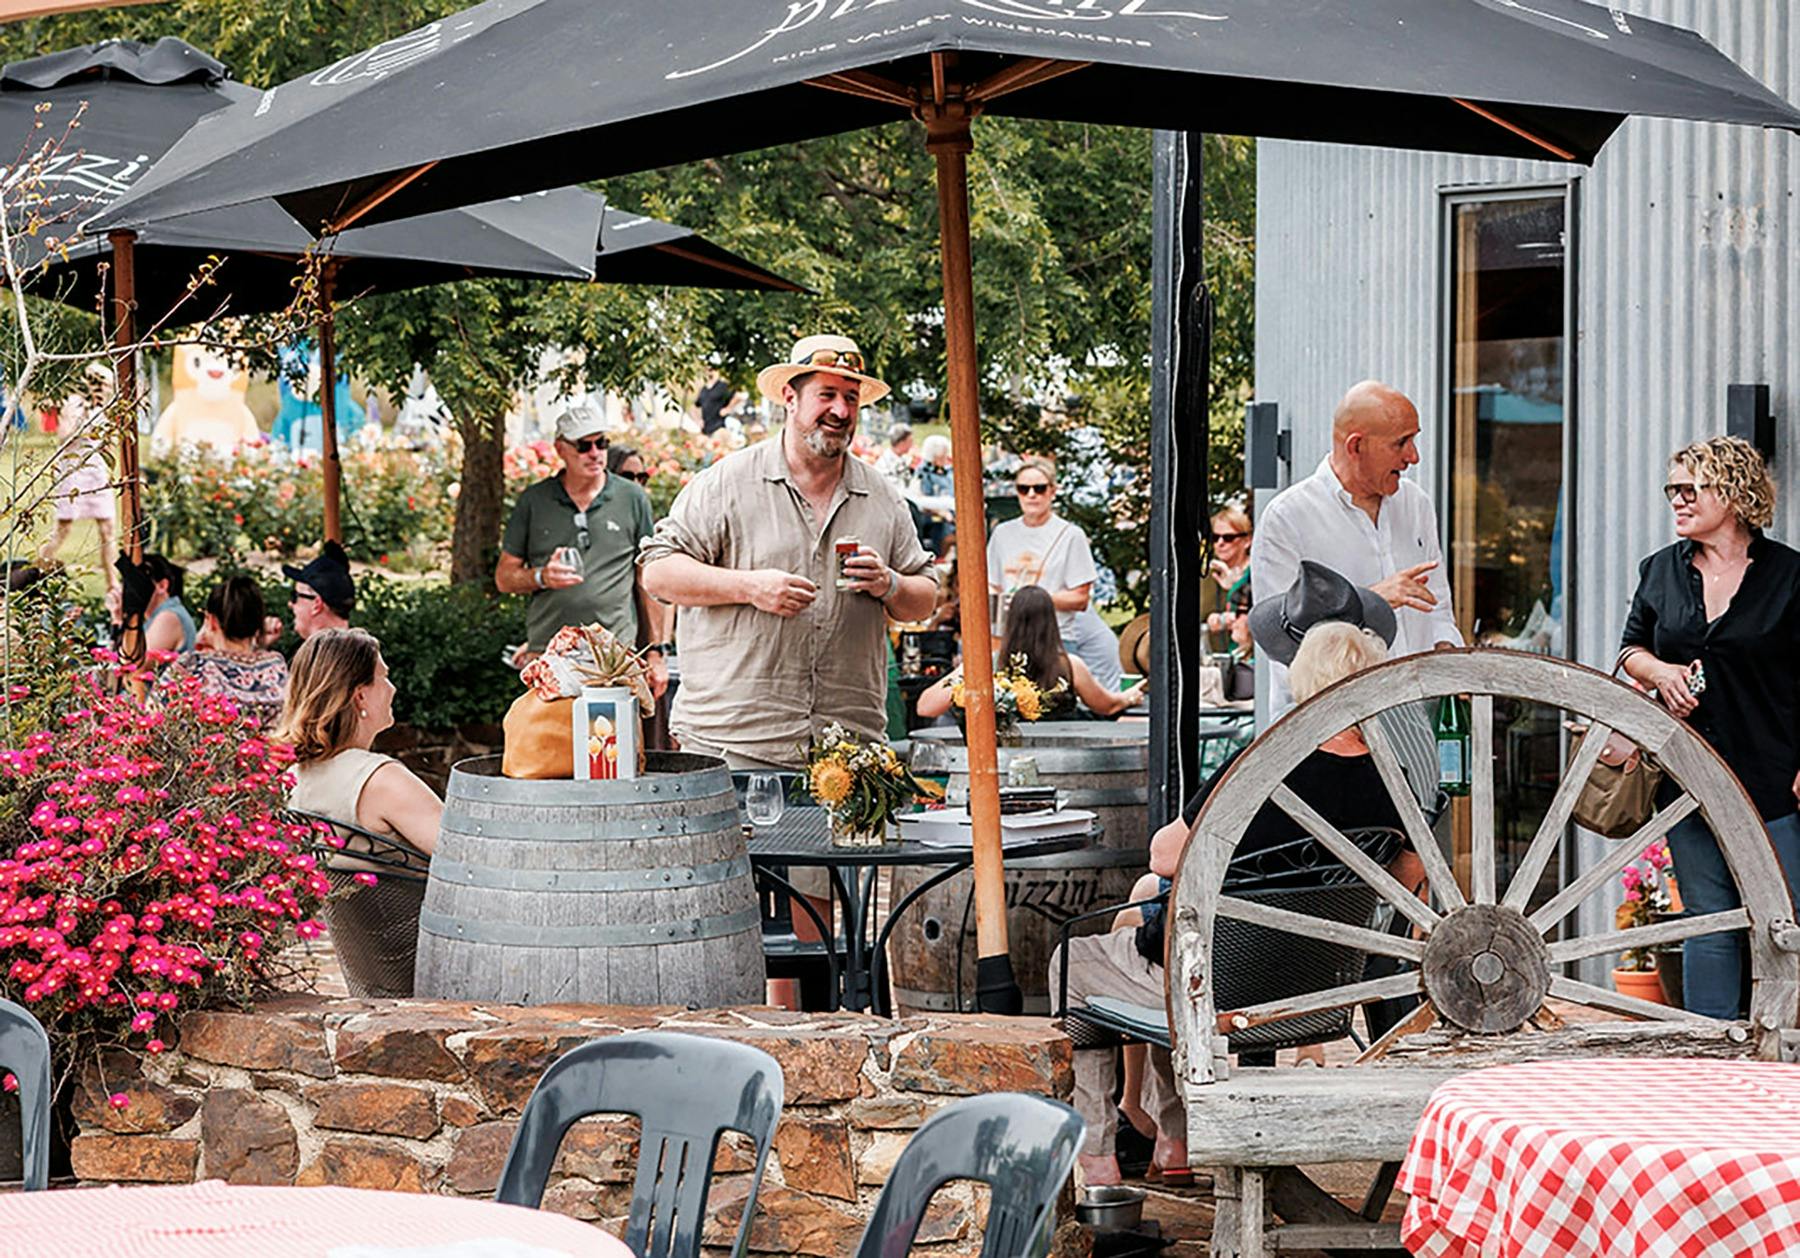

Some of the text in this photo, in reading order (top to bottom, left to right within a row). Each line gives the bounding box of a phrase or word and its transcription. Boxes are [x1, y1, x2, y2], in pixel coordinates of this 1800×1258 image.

[772, 43, 837, 63] KING
[847, 13, 952, 44] VALLEY
[961, 16, 1152, 47] WINEMAKERS
[1004, 869, 1127, 925] izzini
